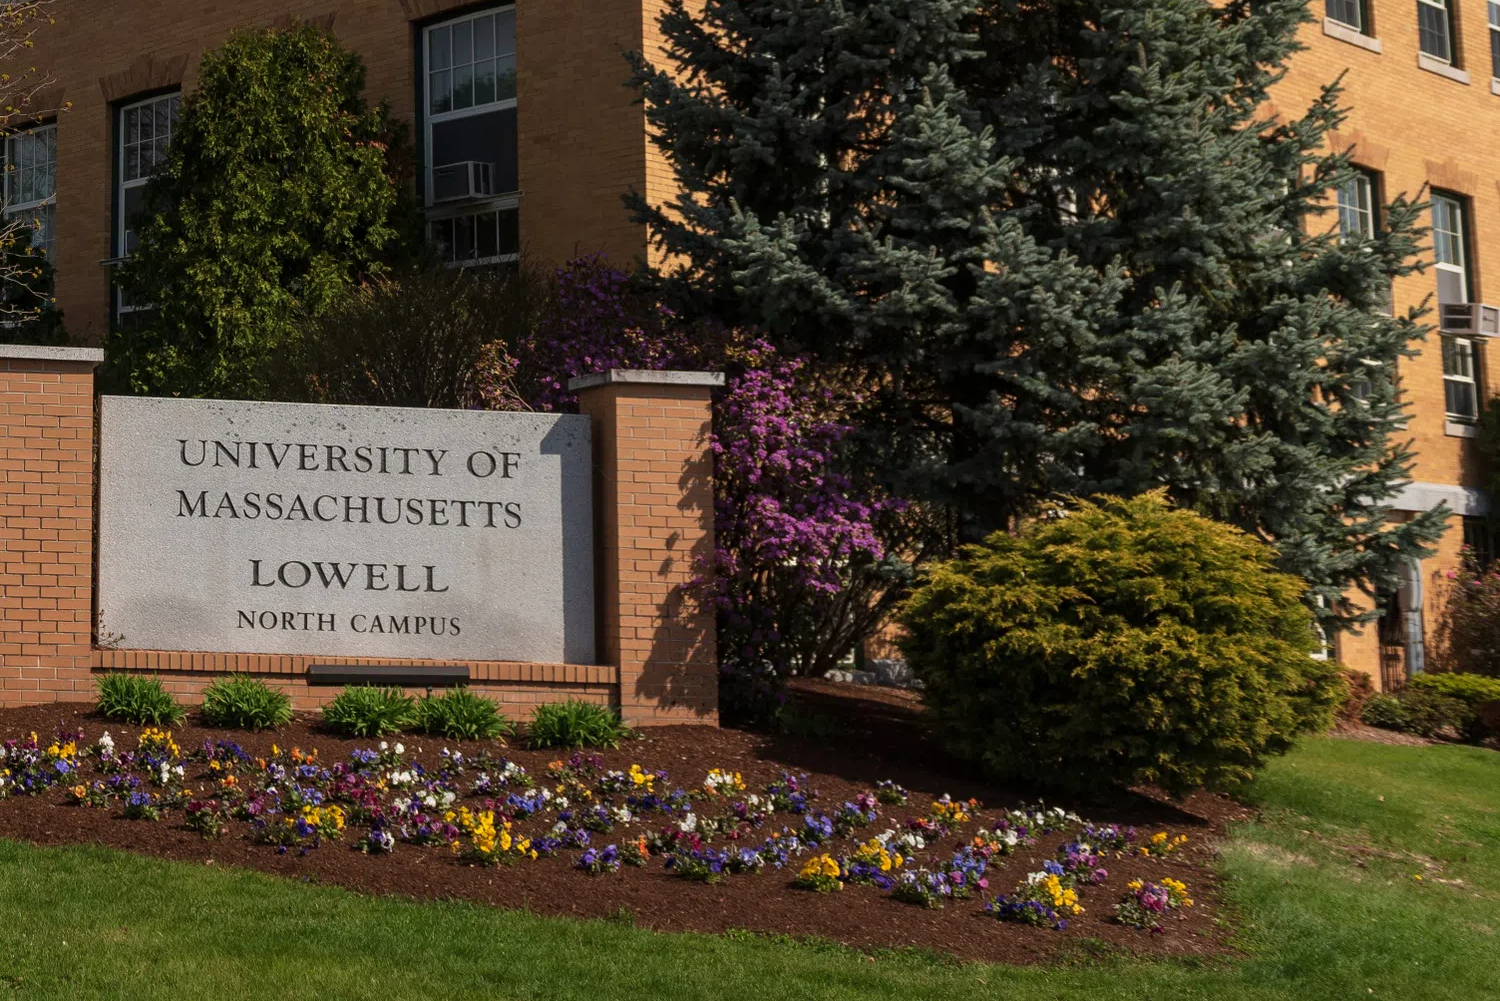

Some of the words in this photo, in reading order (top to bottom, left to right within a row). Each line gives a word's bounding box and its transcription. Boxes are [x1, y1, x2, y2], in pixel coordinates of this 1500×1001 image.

[177, 439, 449, 476] UNIVERSITY
[466, 450, 521, 479] OF
[176, 490, 522, 529] MASSACHUSETTS
[249, 559, 450, 593] LOWELL
[236, 610, 337, 632] NORTH
[350, 615, 461, 637] CAMPUS
